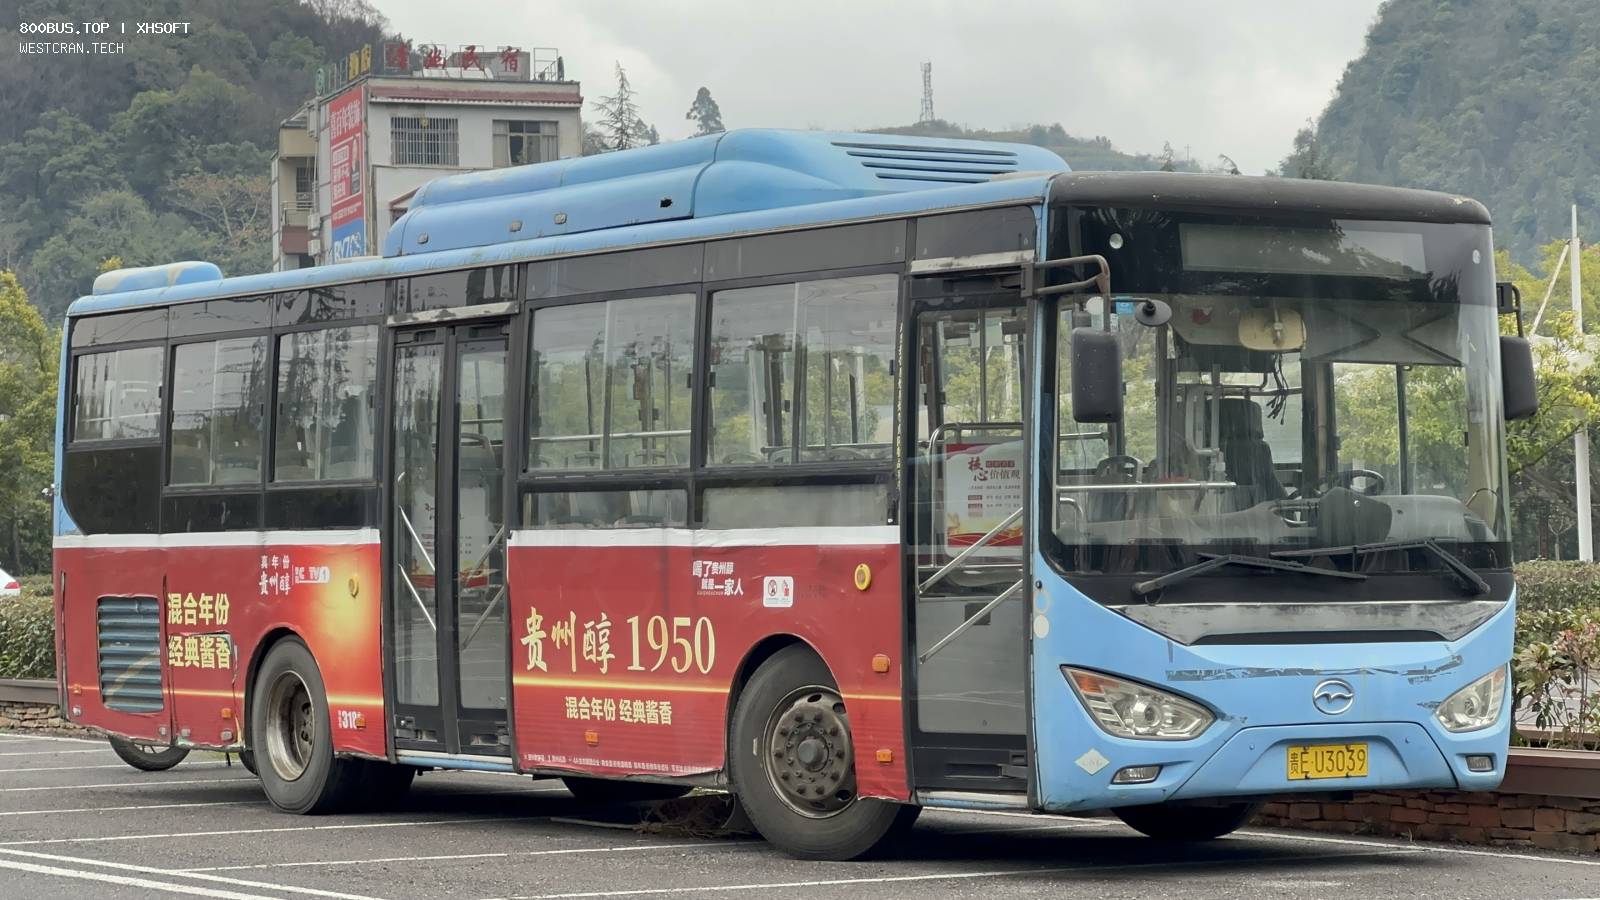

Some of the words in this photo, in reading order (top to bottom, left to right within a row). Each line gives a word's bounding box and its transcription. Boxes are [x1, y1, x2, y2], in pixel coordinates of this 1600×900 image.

[258, 570, 292, 596] 贵州醇
[167, 592, 230, 626] 混合年份
[168, 636, 231, 670] 经典酱香
[520, 606, 616, 674] 贵州醇
[626, 614, 716, 675] 1950
[565, 696, 616, 722] 混合年份
[619, 698, 672, 726] 经典酱香
